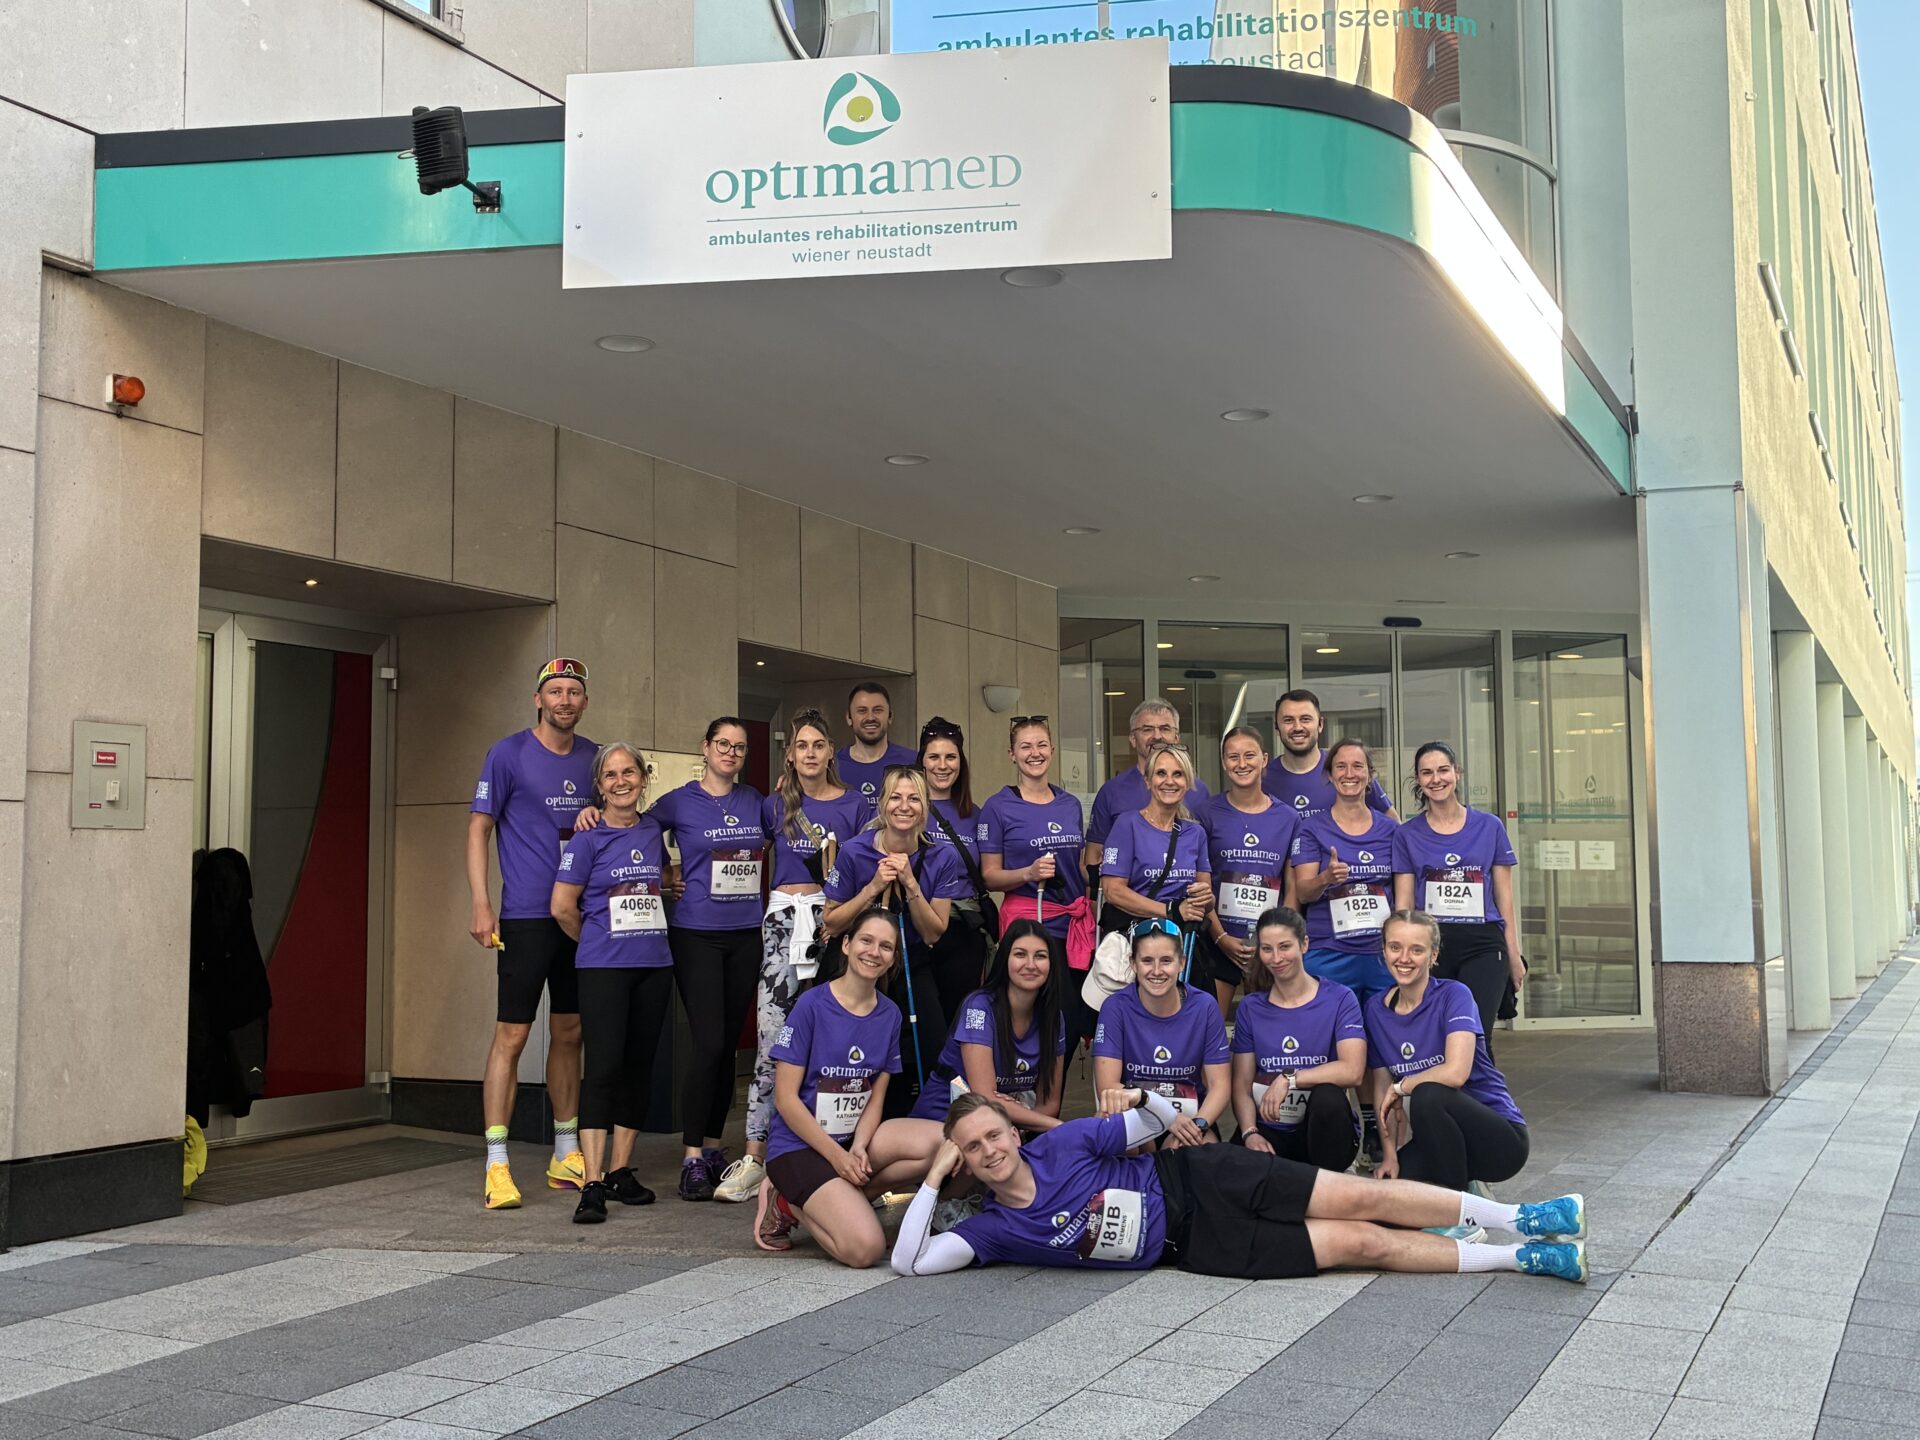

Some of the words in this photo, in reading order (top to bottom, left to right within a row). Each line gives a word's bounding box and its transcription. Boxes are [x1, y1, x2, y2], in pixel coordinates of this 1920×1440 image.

[708, 228, 811, 246] ambulantes
[815, 218, 1018, 241] rehabilitationszentrum
[791, 247, 851, 264] wiener
[856, 243, 932, 261] neustadt
[721, 864, 758, 876] 4066A
[1233, 886, 1268, 902] 183B
[1436, 884, 1473, 898] 182A
[619, 898, 658, 911] 4066C
[1343, 897, 1379, 912] 182B
[833, 1096, 865, 1112] 179C
[1100, 1205, 1121, 1249] 181B
